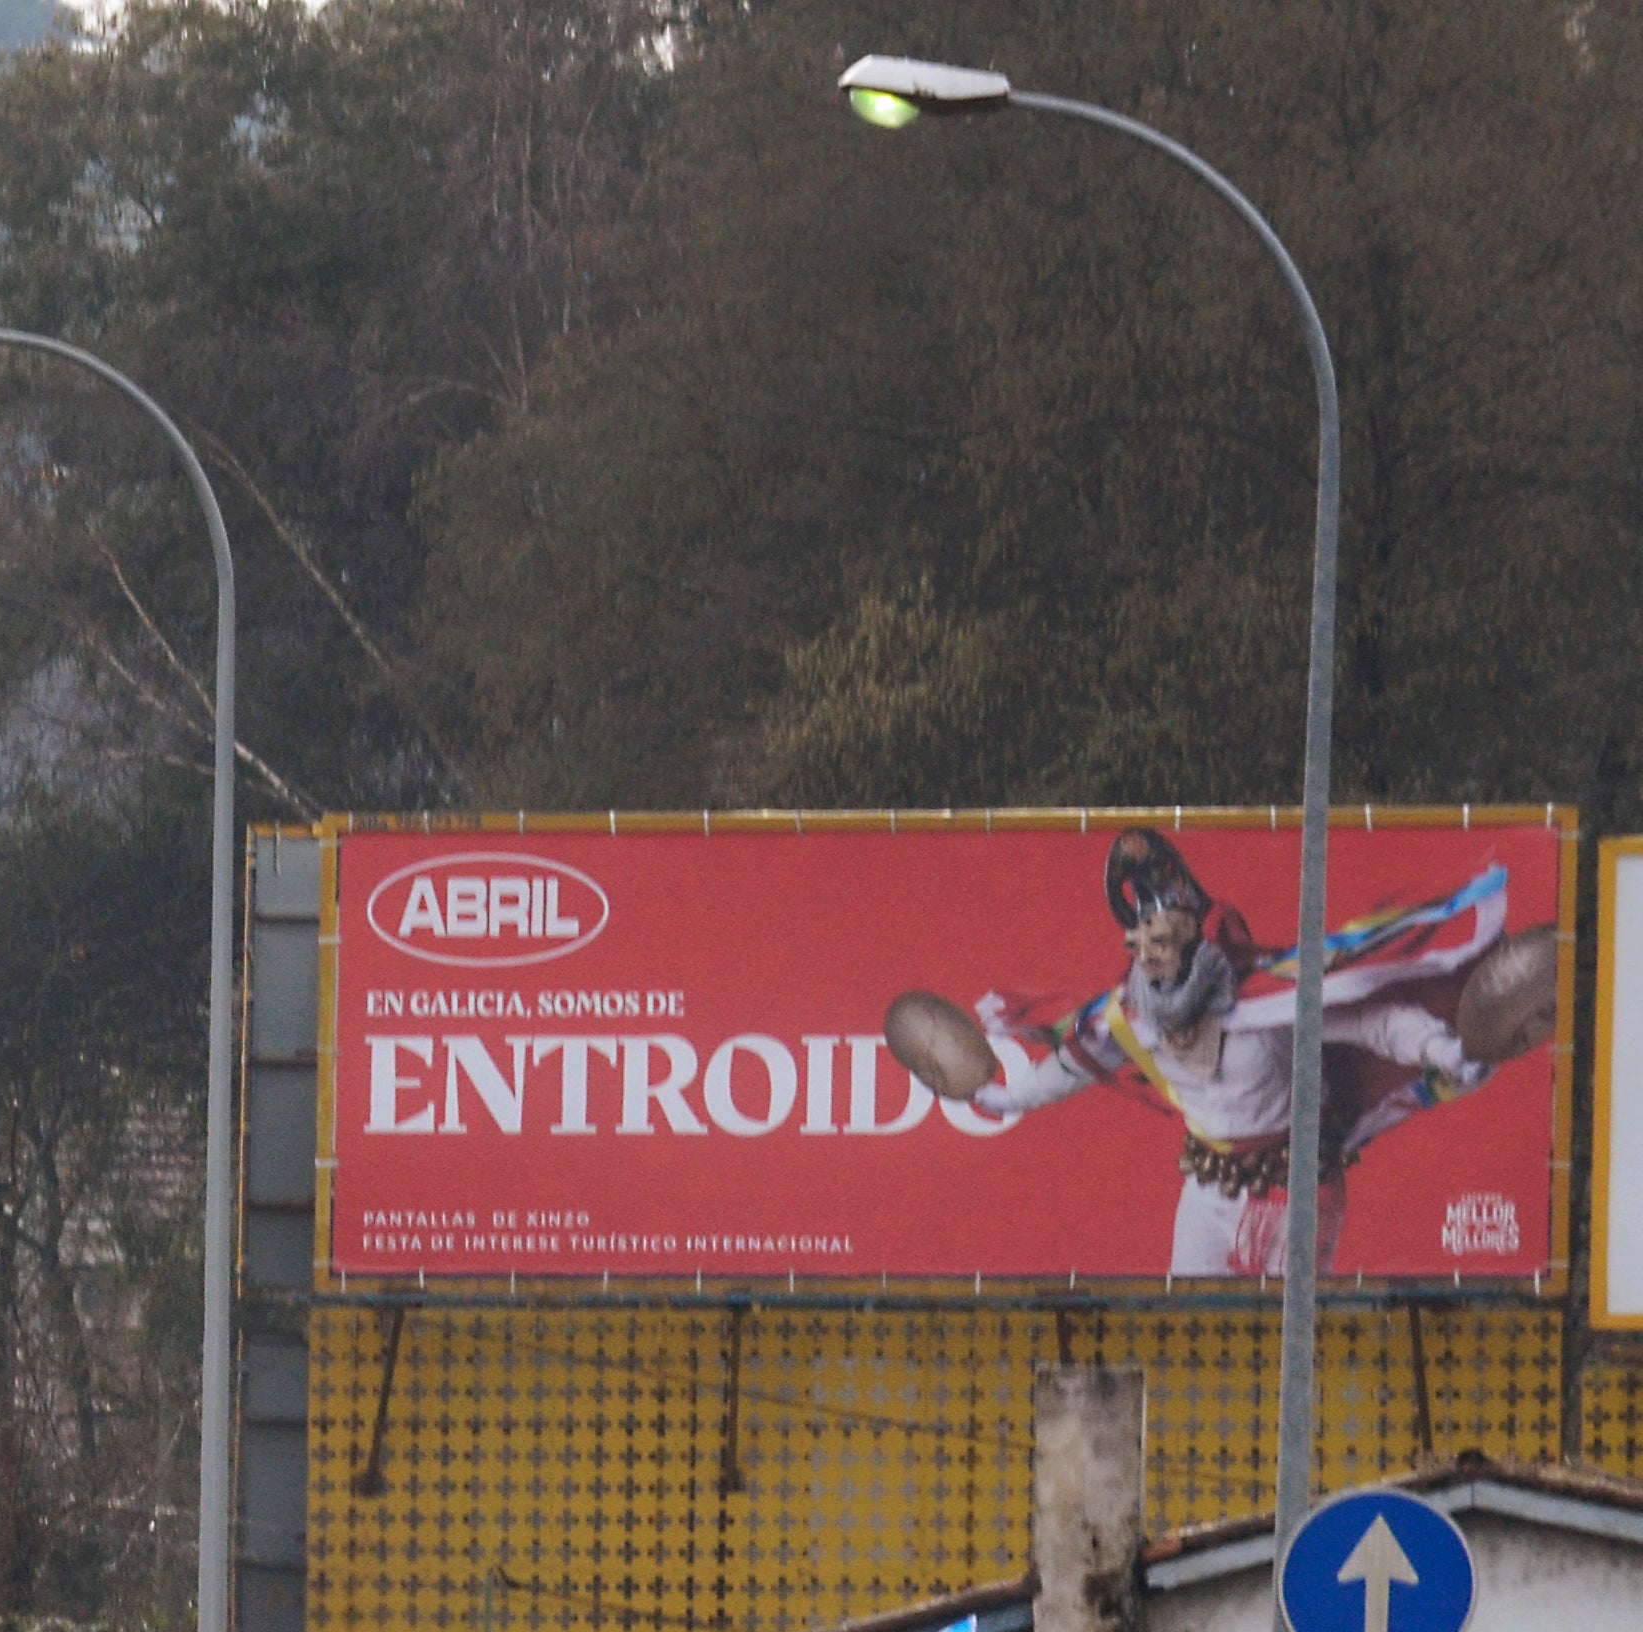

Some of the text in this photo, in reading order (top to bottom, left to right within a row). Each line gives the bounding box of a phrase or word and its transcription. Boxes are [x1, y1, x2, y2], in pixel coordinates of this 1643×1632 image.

[398, 876, 580, 939] ABRIL
[367, 990, 685, 1019] EN GALICIA, SOMOS DE
[363, 1209, 477, 1229] PANTALLAS
[492, 1209, 517, 1229] DE
[363, 1230, 854, 1252] FESTA DE INTERESE TURÍSTICO INTERNACIONAL
